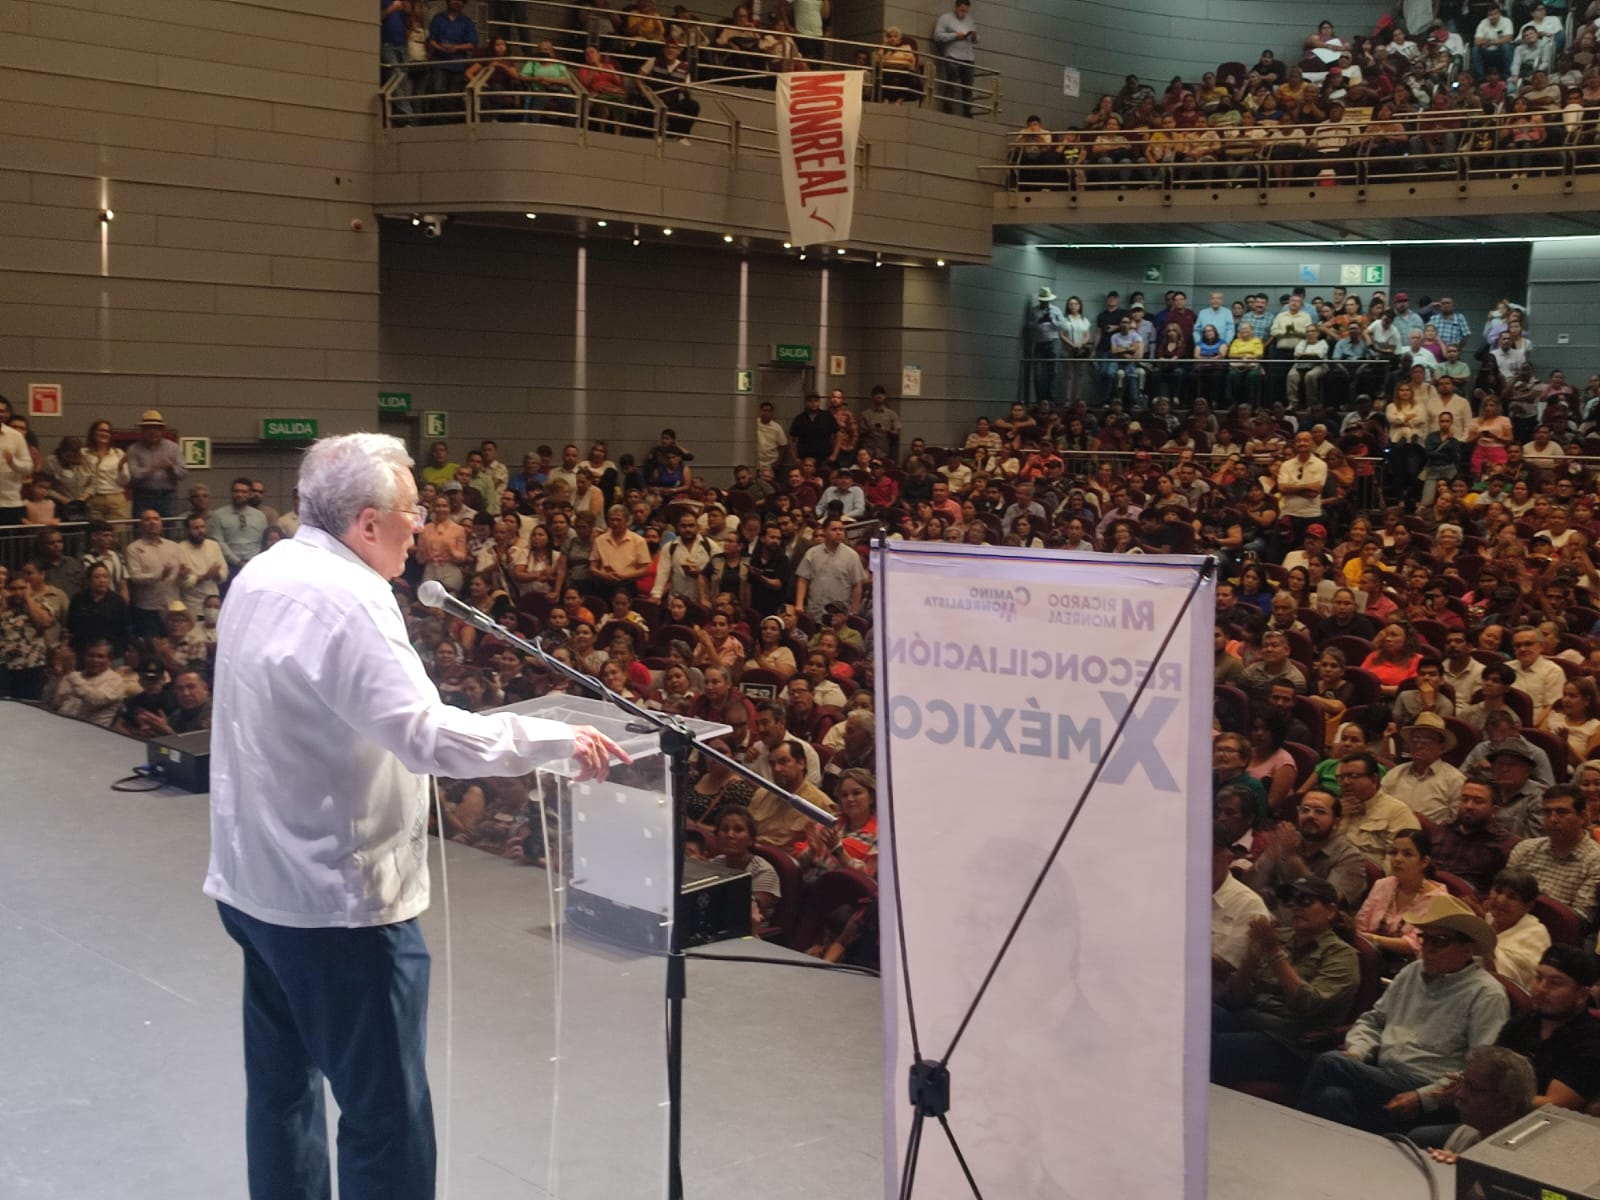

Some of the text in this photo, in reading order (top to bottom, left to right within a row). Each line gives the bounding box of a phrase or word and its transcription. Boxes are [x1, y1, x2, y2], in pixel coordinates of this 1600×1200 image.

[789, 73, 848, 208] MONREAL
[778, 347, 809, 358] SALIDA
[268, 422, 313, 435] SALIDA
